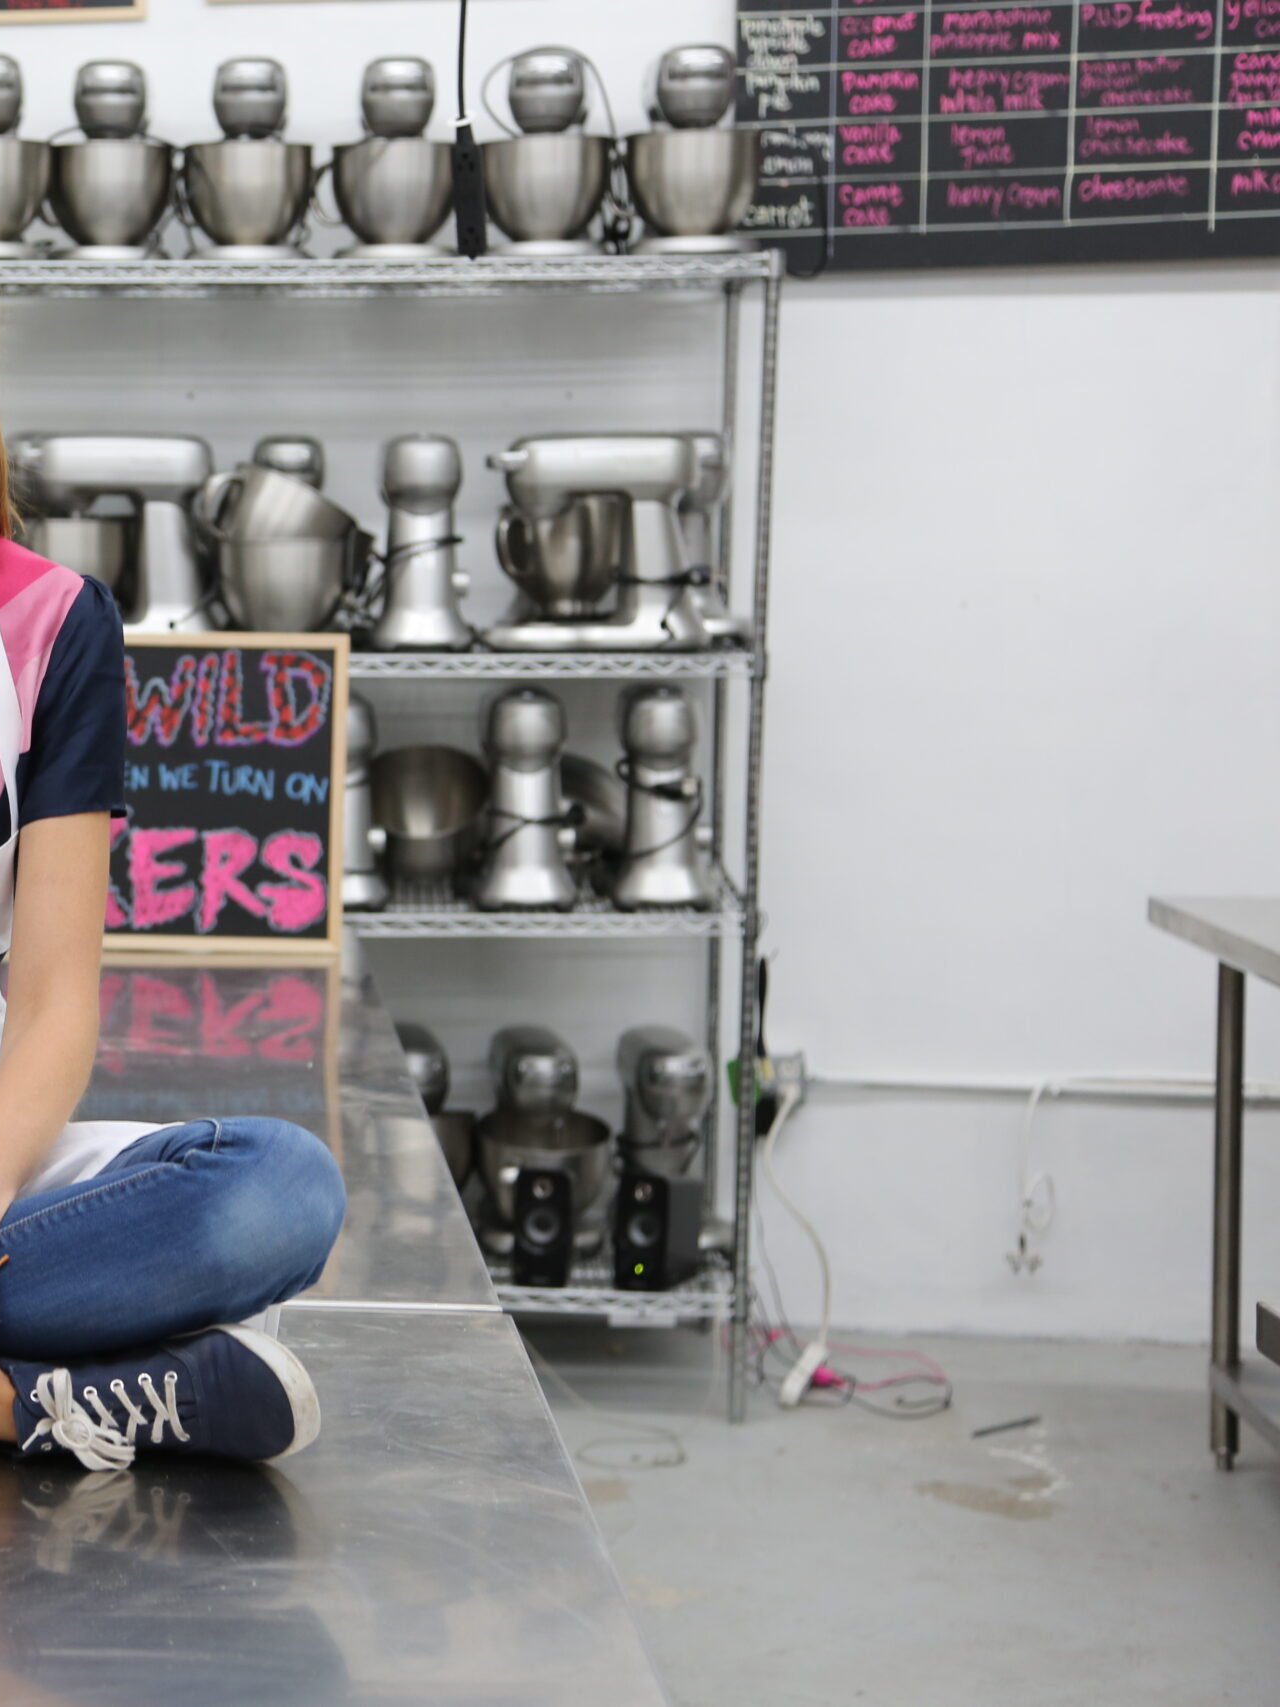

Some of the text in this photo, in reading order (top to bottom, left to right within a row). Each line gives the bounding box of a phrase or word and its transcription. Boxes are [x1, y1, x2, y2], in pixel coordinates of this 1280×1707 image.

[840, 11, 917, 35] coconut
[1135, 0, 1213, 40] frosting
[847, 35, 896, 58] cake
[1023, 30, 1060, 50] mix
[949, 66, 1010, 95] heavy
[849, 94, 896, 115] cake
[1003, 86, 1045, 111] milk
[951, 123, 1006, 146] lemon
[1086, 115, 1140, 137] lemon
[842, 145, 895, 165] cake
[948, 182, 1005, 217] heavy
[843, 206, 891, 227] cake
[124, 648, 332, 747] WILD
[158, 762, 199, 792] WE
[204, 759, 274, 800] TURN
[284, 772, 329, 805] ON
